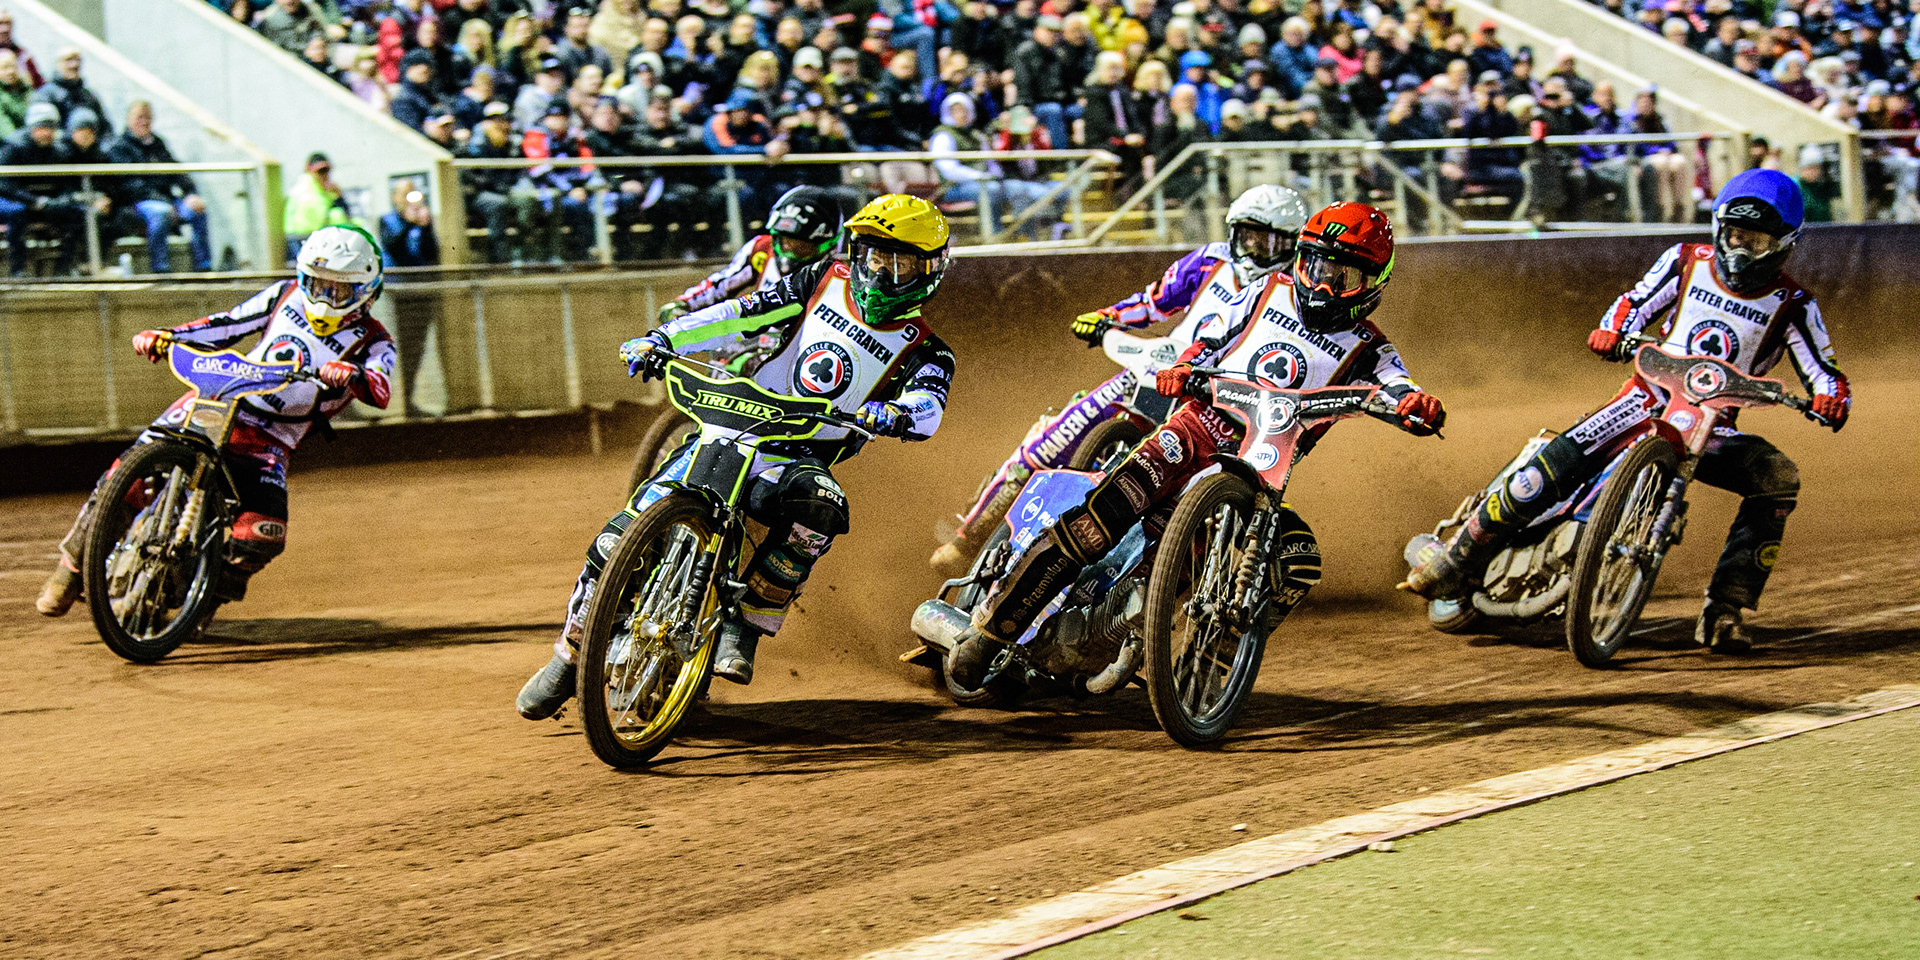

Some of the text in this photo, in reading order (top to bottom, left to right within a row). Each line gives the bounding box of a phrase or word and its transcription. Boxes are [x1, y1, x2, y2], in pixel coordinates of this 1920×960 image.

[1689, 286, 1770, 326] PETER CRAVEN
[1774, 289, 1788, 301] 4
[281, 305, 346, 355] PETER CAVEN
[353, 326, 369, 339] 2
[813, 303, 894, 365] PETER CRAVEN
[901, 324, 919, 343] 9
[1262, 307, 1347, 362] PETER CRAVEN
[1352, 324, 1374, 343] 16
[805, 342, 851, 382] BELLE VUE ACES
[1258, 343, 1306, 379] BELLE VUE ACES
[701, 394, 777, 420] TRU MIX
[1035, 409, 1090, 464] HANSEN
[1082, 401, 1100, 420] &
[817, 488, 843, 507] BOLL
[1518, 473, 1534, 494] ATPI
[1077, 519, 1105, 551] AMD
